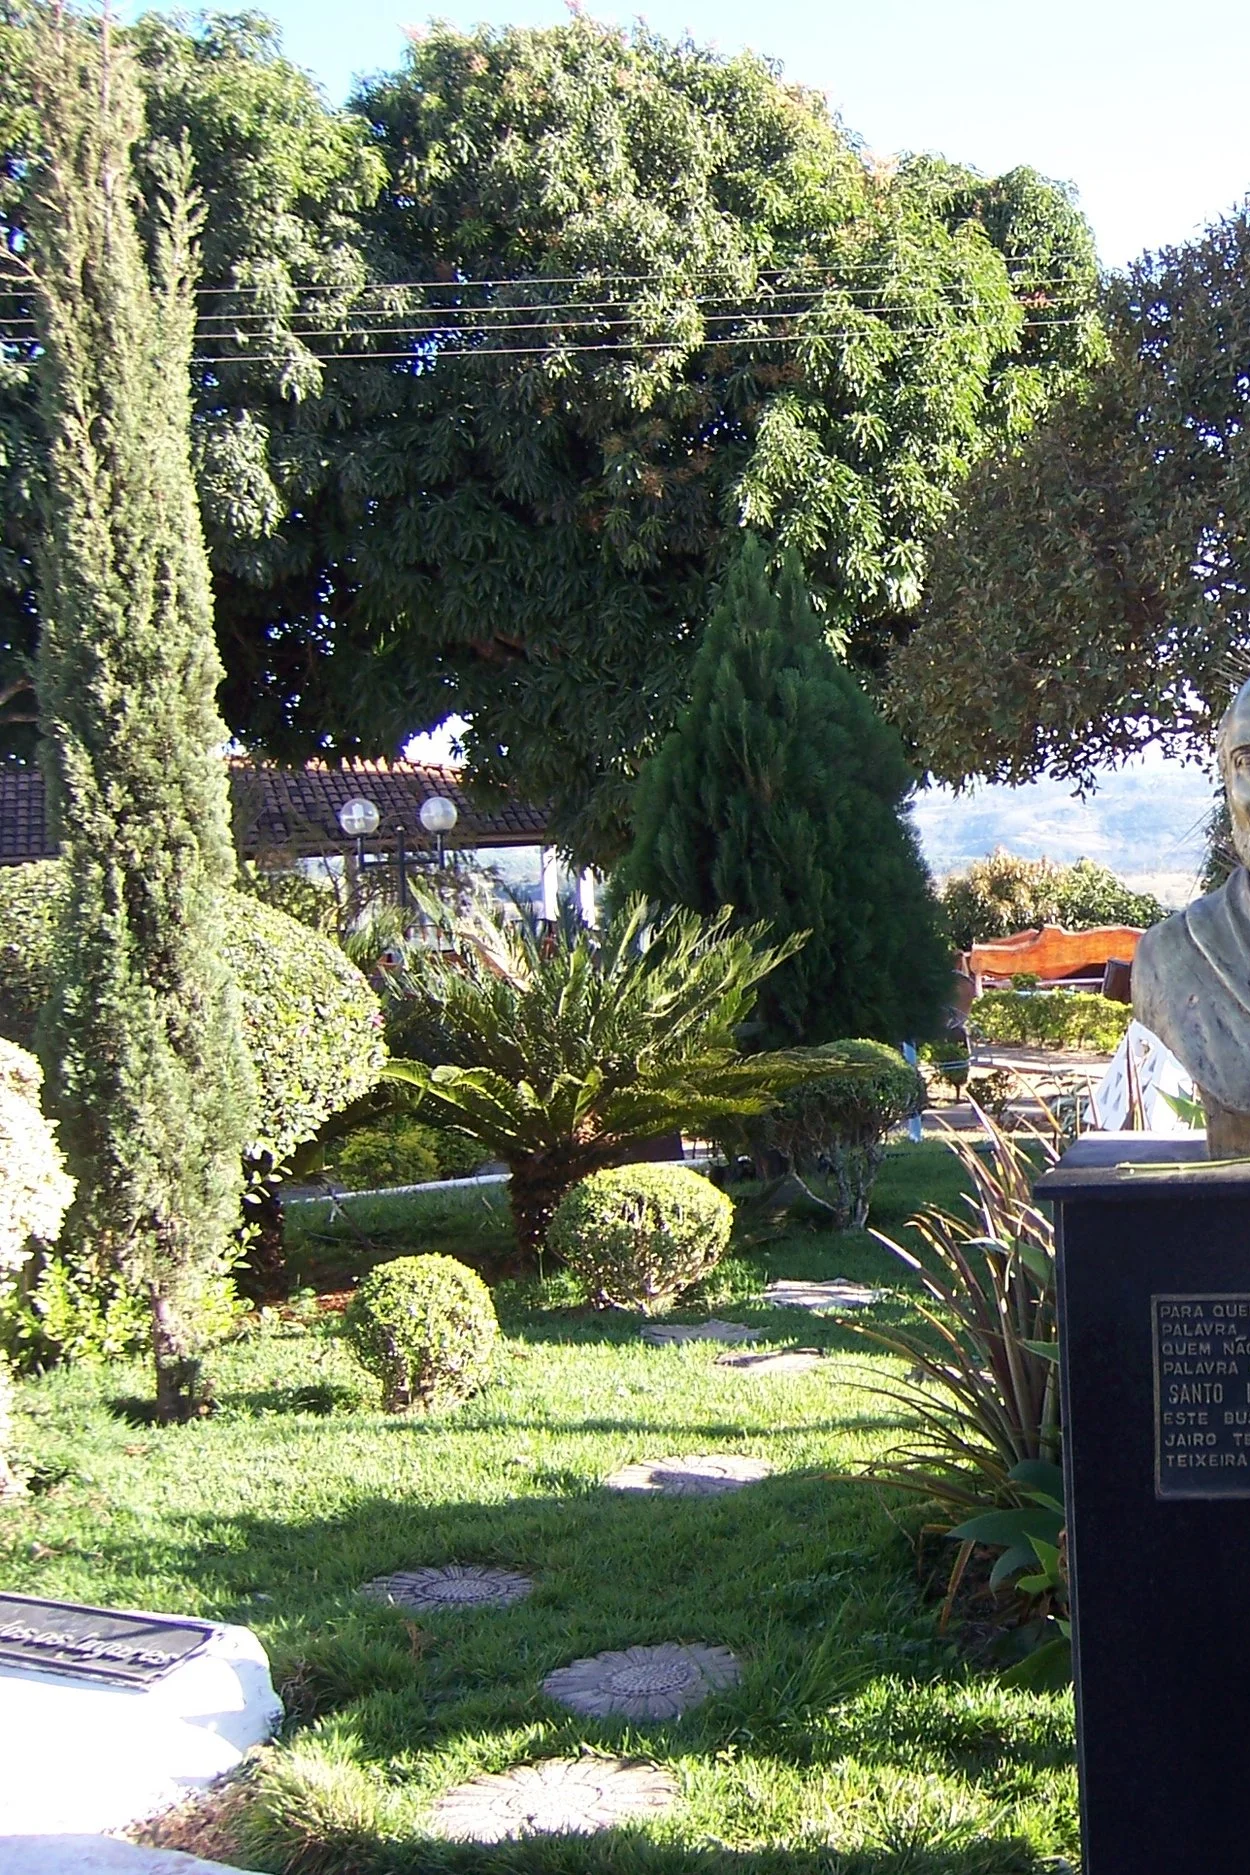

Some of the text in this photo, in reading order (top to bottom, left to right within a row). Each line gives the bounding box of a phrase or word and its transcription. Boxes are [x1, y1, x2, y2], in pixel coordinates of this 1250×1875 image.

[1160, 1305, 1204, 1318] PARA
[1161, 1323, 1237, 1336] PALAVRA
[1162, 1341, 1212, 1356] QUEM
[1163, 1361, 1239, 1375] PALAVRA
[1168, 1383, 1223, 1404] SANTO
[1163, 1412, 1209, 1425] ESTE
[1164, 1433, 1217, 1446] JAIRO
[1166, 1454, 1248, 1467] TEIXEIRA
